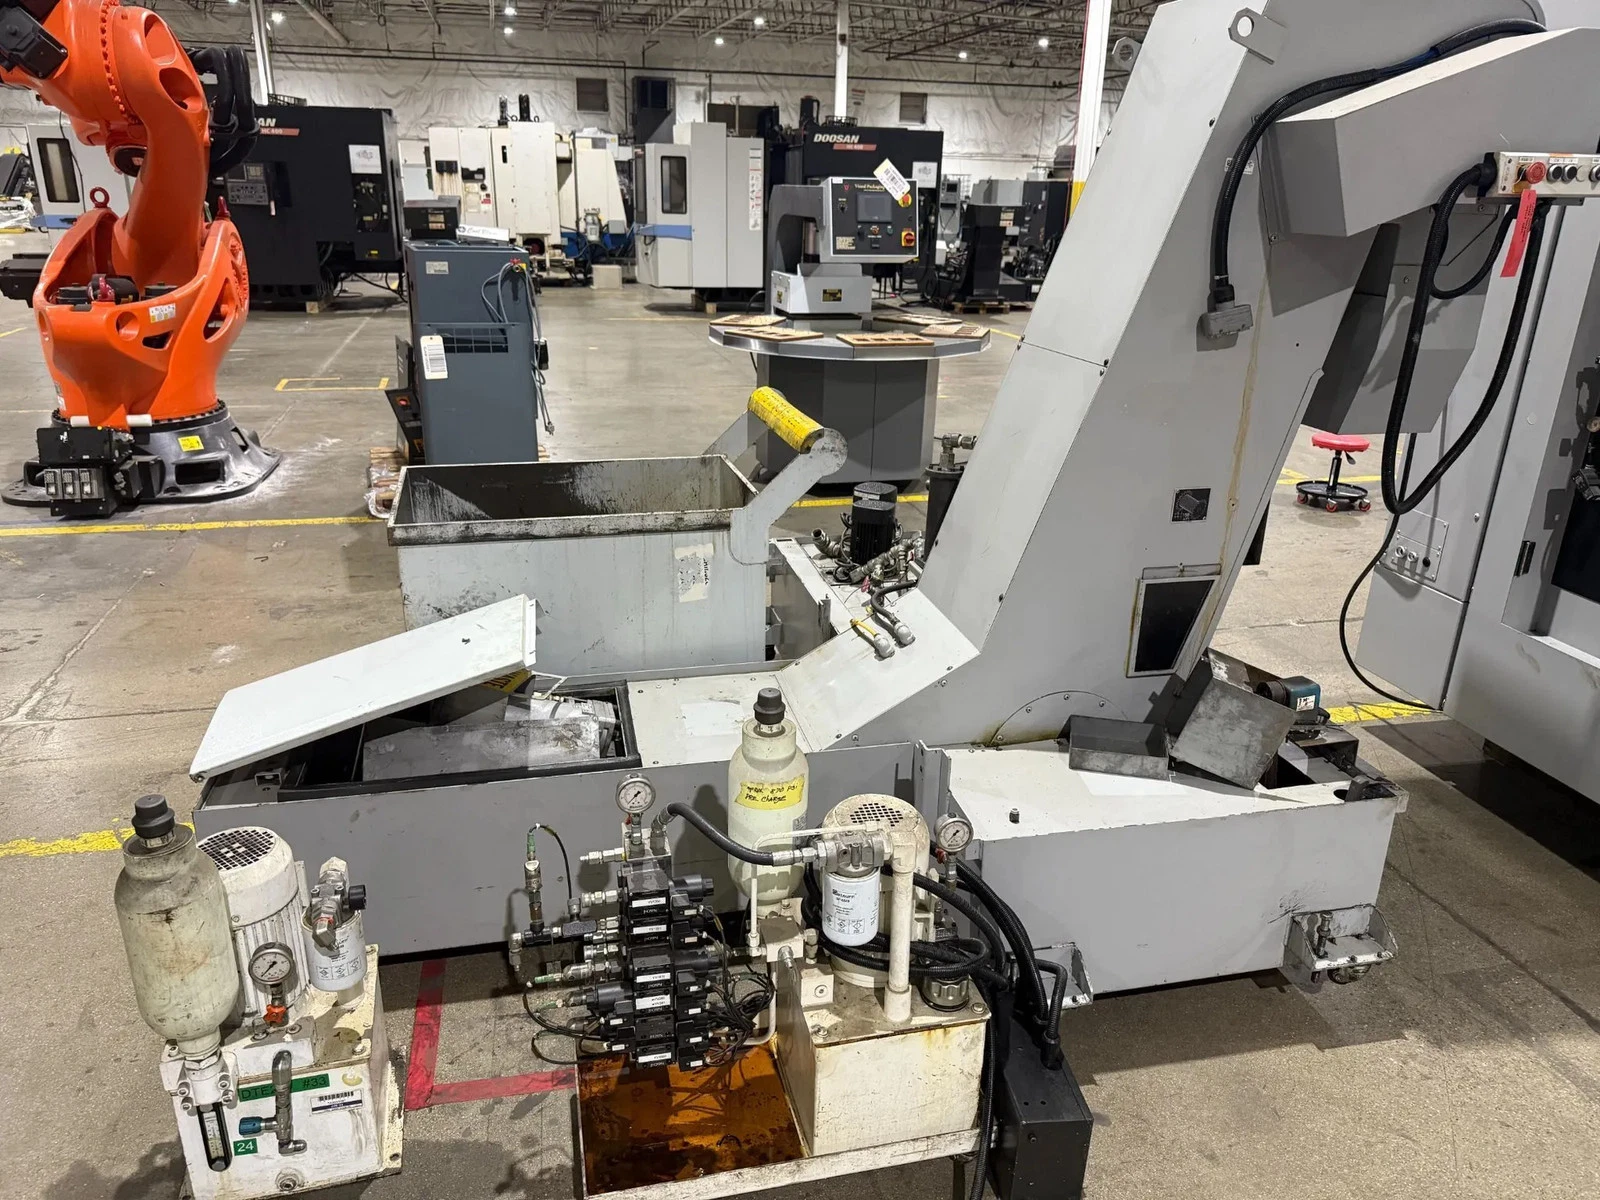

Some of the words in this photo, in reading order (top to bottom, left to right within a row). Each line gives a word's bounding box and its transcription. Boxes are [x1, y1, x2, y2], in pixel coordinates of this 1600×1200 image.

[813, 133, 860, 144] DOOSAN
[302, 1076, 327, 1088] #33
[237, 1141, 255, 1153] 24
